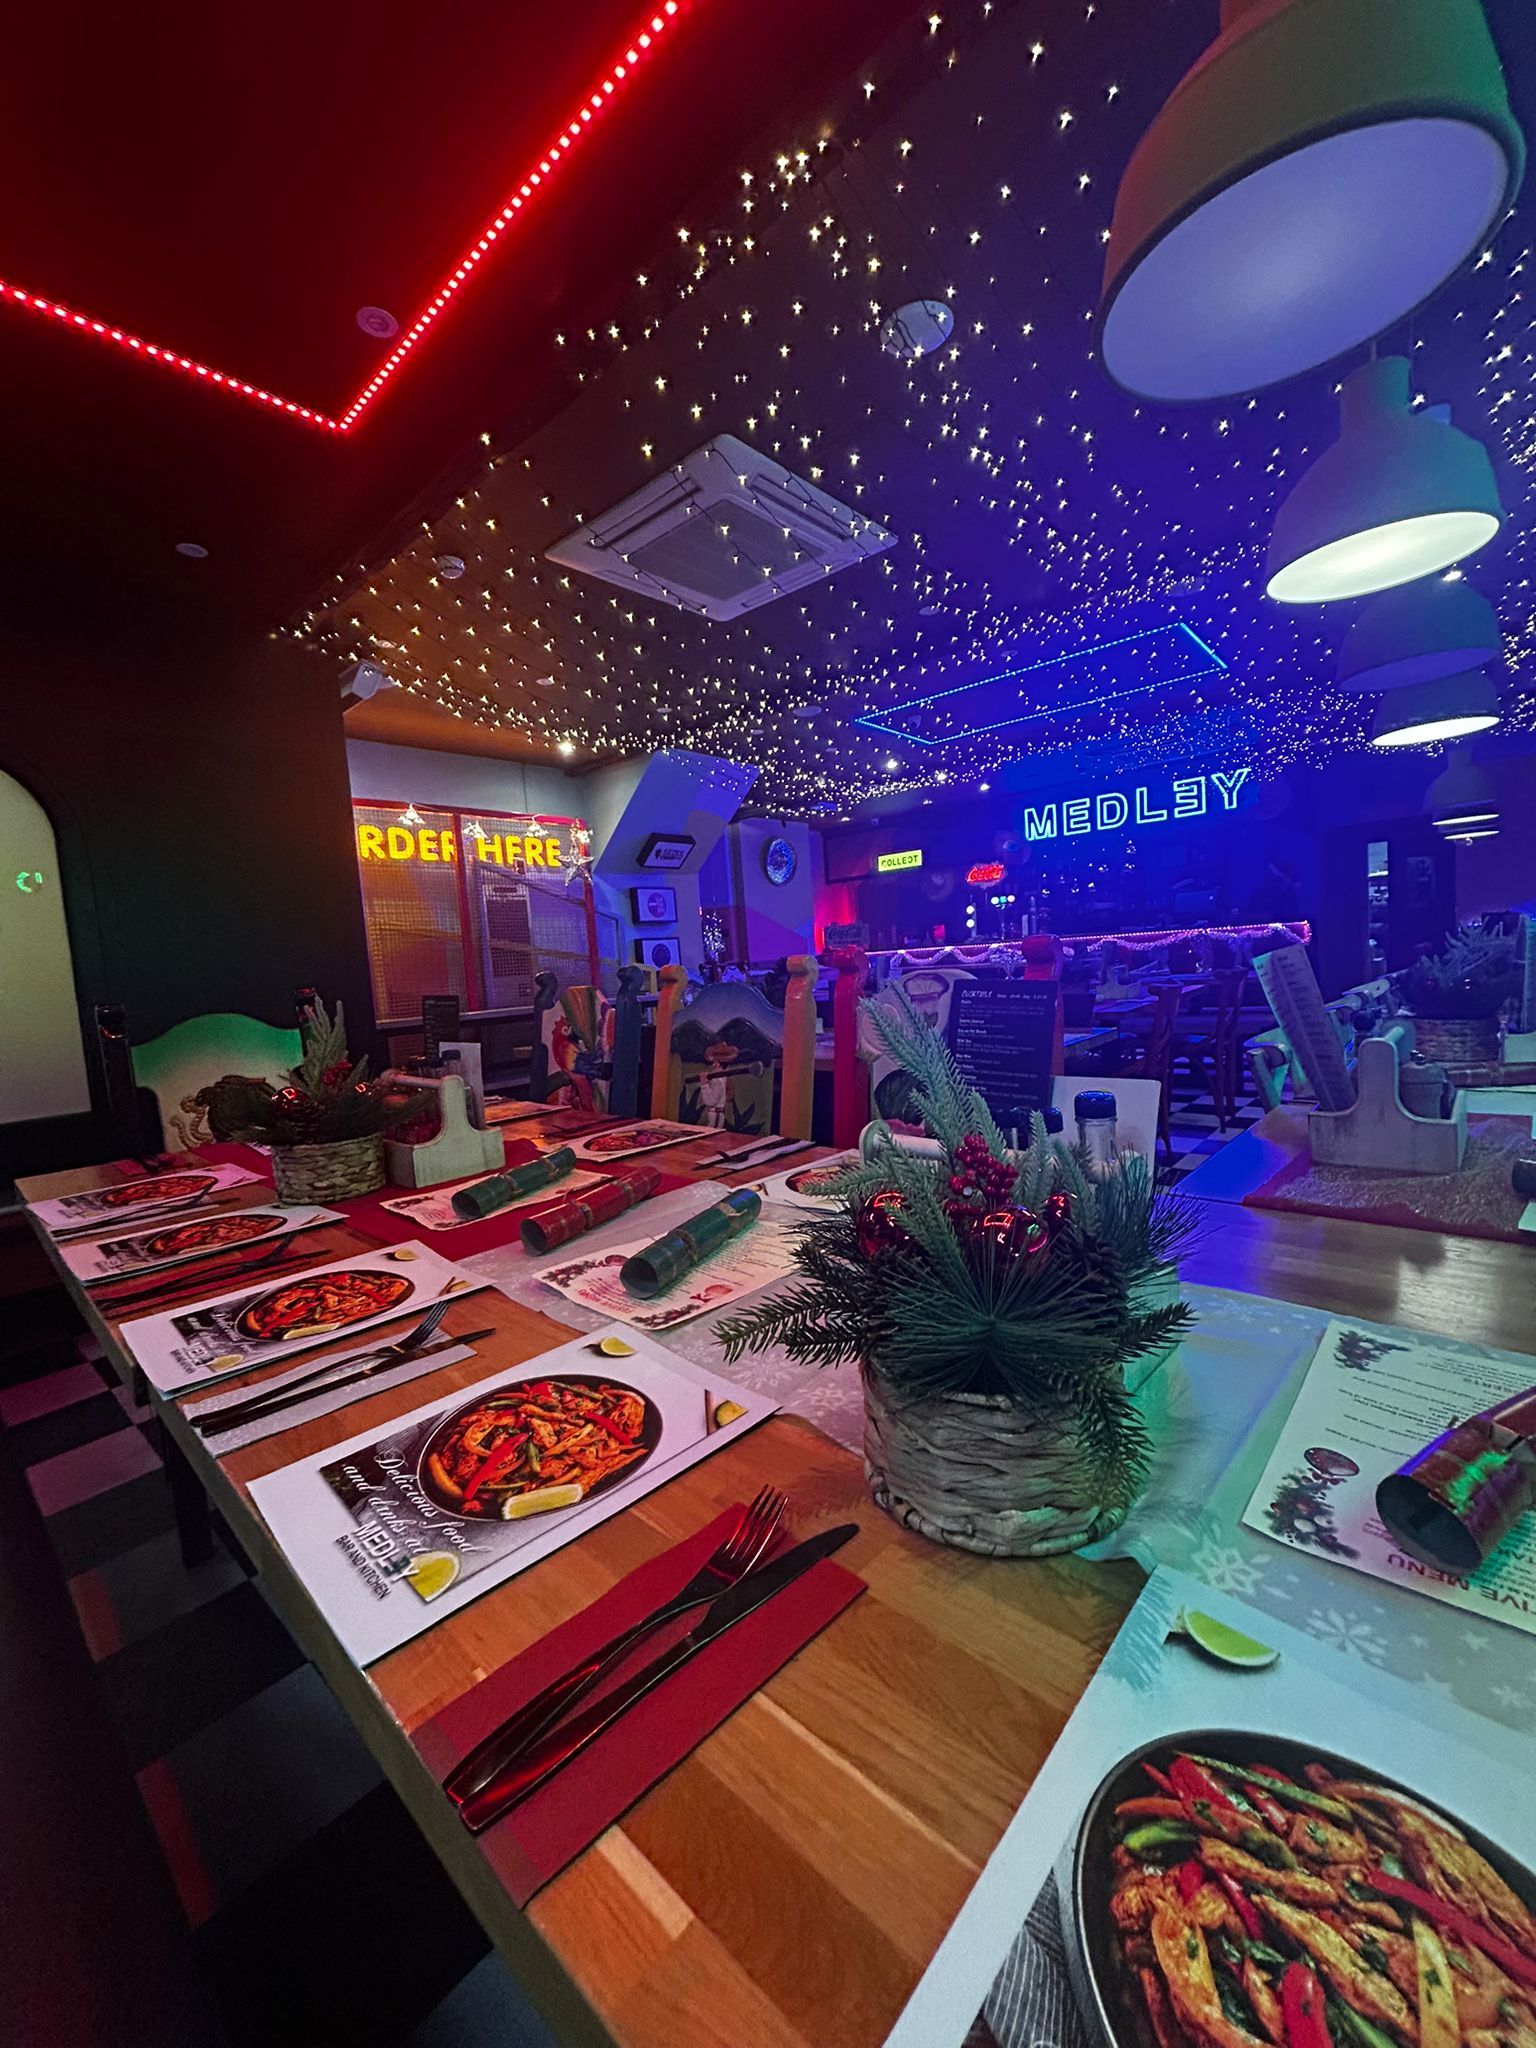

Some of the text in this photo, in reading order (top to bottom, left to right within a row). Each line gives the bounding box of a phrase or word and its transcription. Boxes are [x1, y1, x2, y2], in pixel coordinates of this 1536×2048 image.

[1024, 768, 1252, 841] MEDLEY
[477, 834, 562, 867] HERE
[881, 855, 919, 867] COLLECT
[343, 1464, 387, 1492] and
[368, 1496, 416, 1534] drinks
[374, 1449, 491, 1553] Delicious food
[335, 1534, 392, 1601] BAR AND KITCHEN
[1387, 1553, 1470, 1591] MENU
